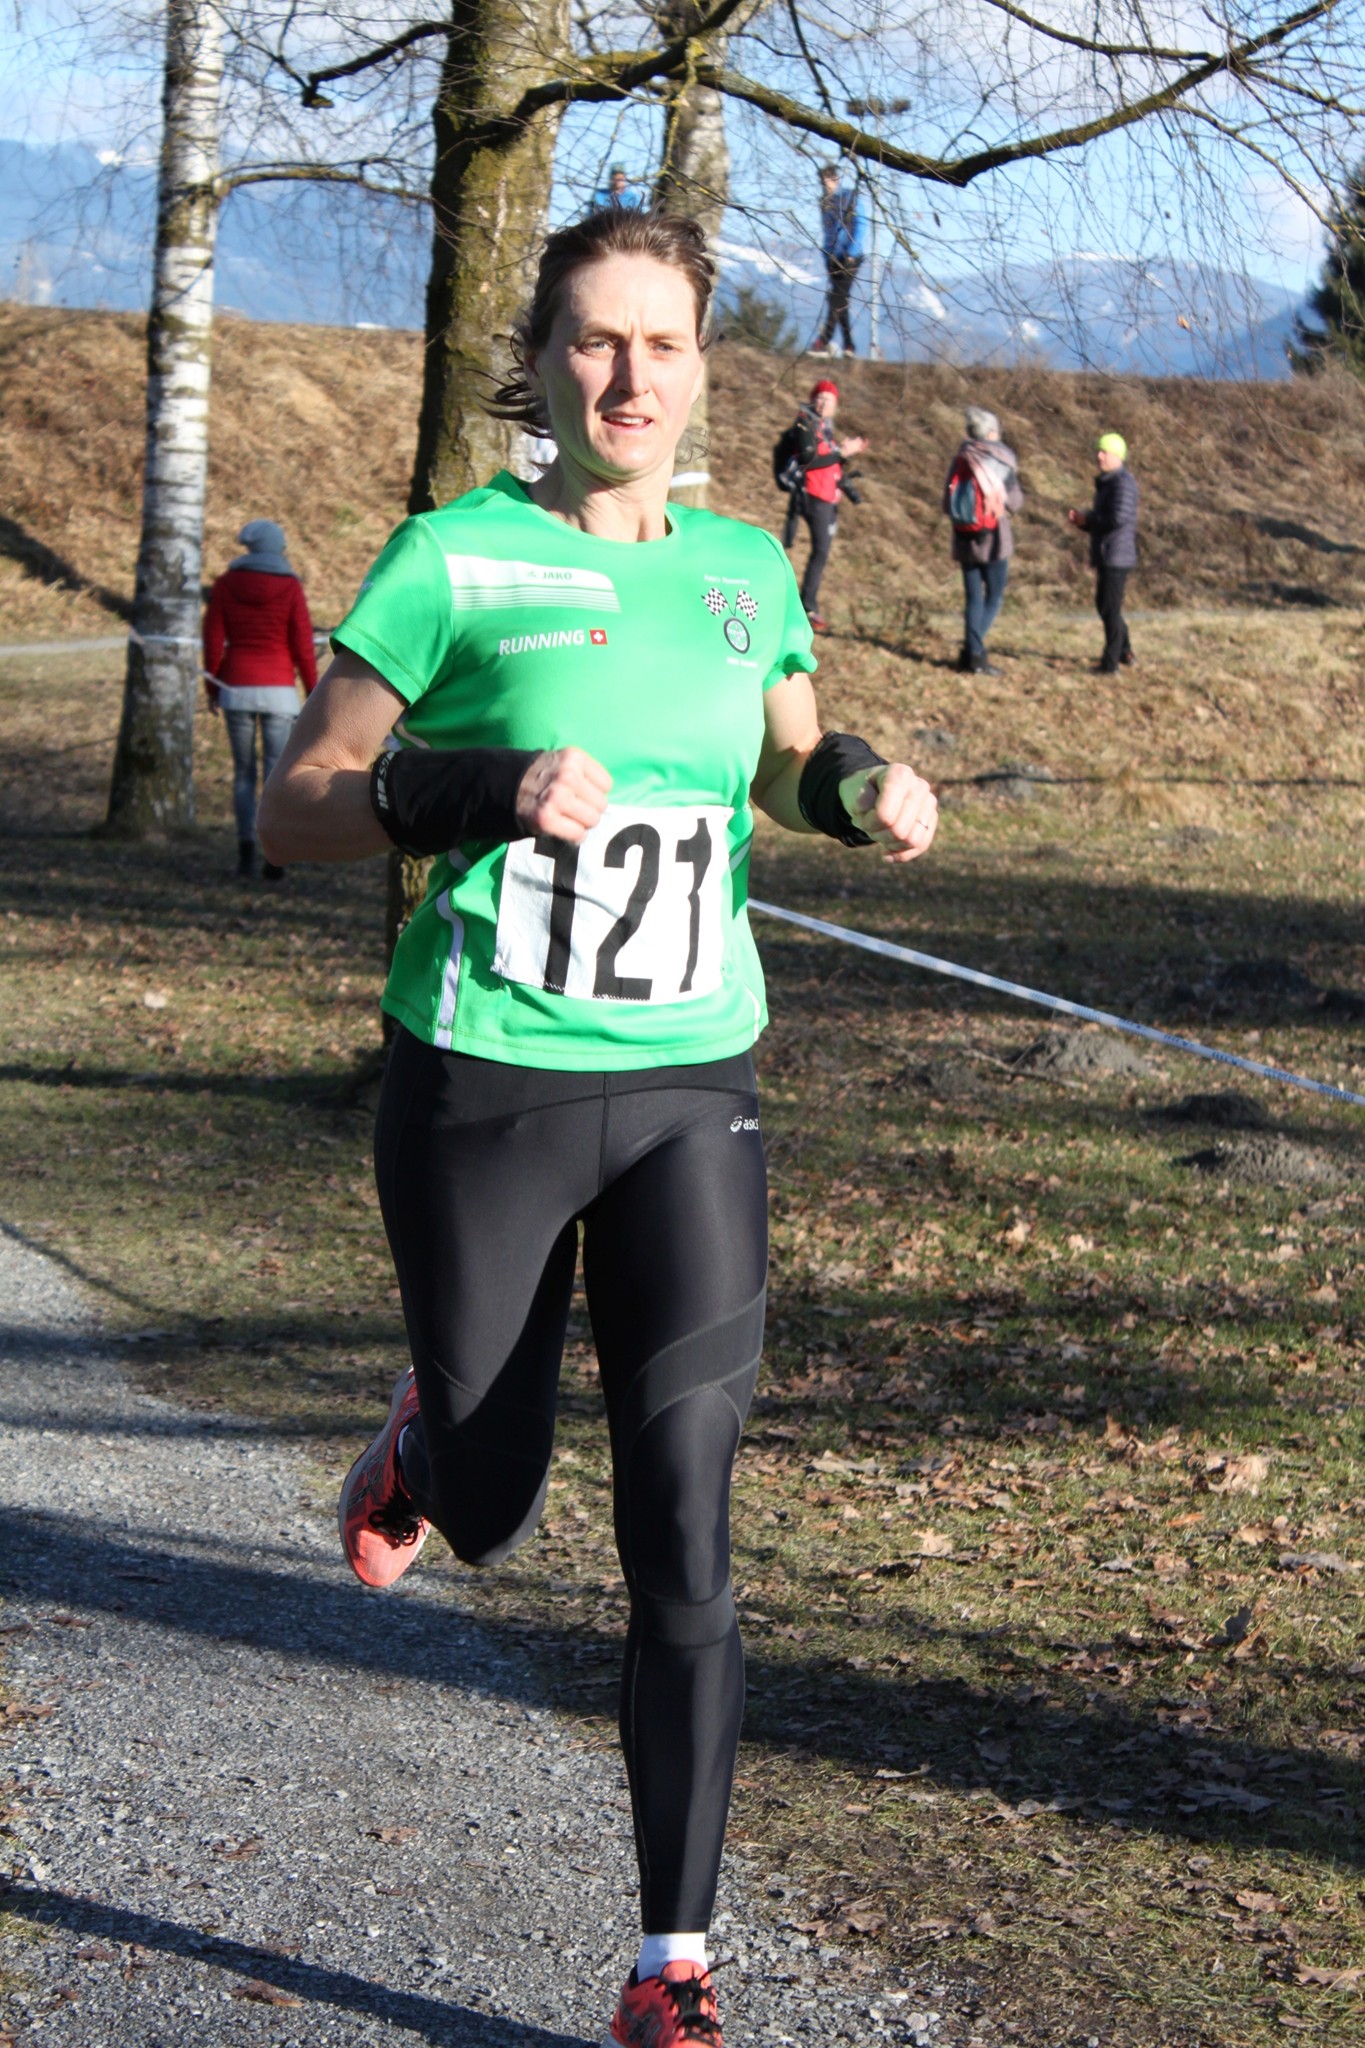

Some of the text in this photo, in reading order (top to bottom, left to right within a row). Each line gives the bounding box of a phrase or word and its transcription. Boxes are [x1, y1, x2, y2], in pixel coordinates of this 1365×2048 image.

[541, 571, 573, 580] JAKO
[498, 629, 585, 656] RUNNING
[533, 817, 712, 1001] 121
